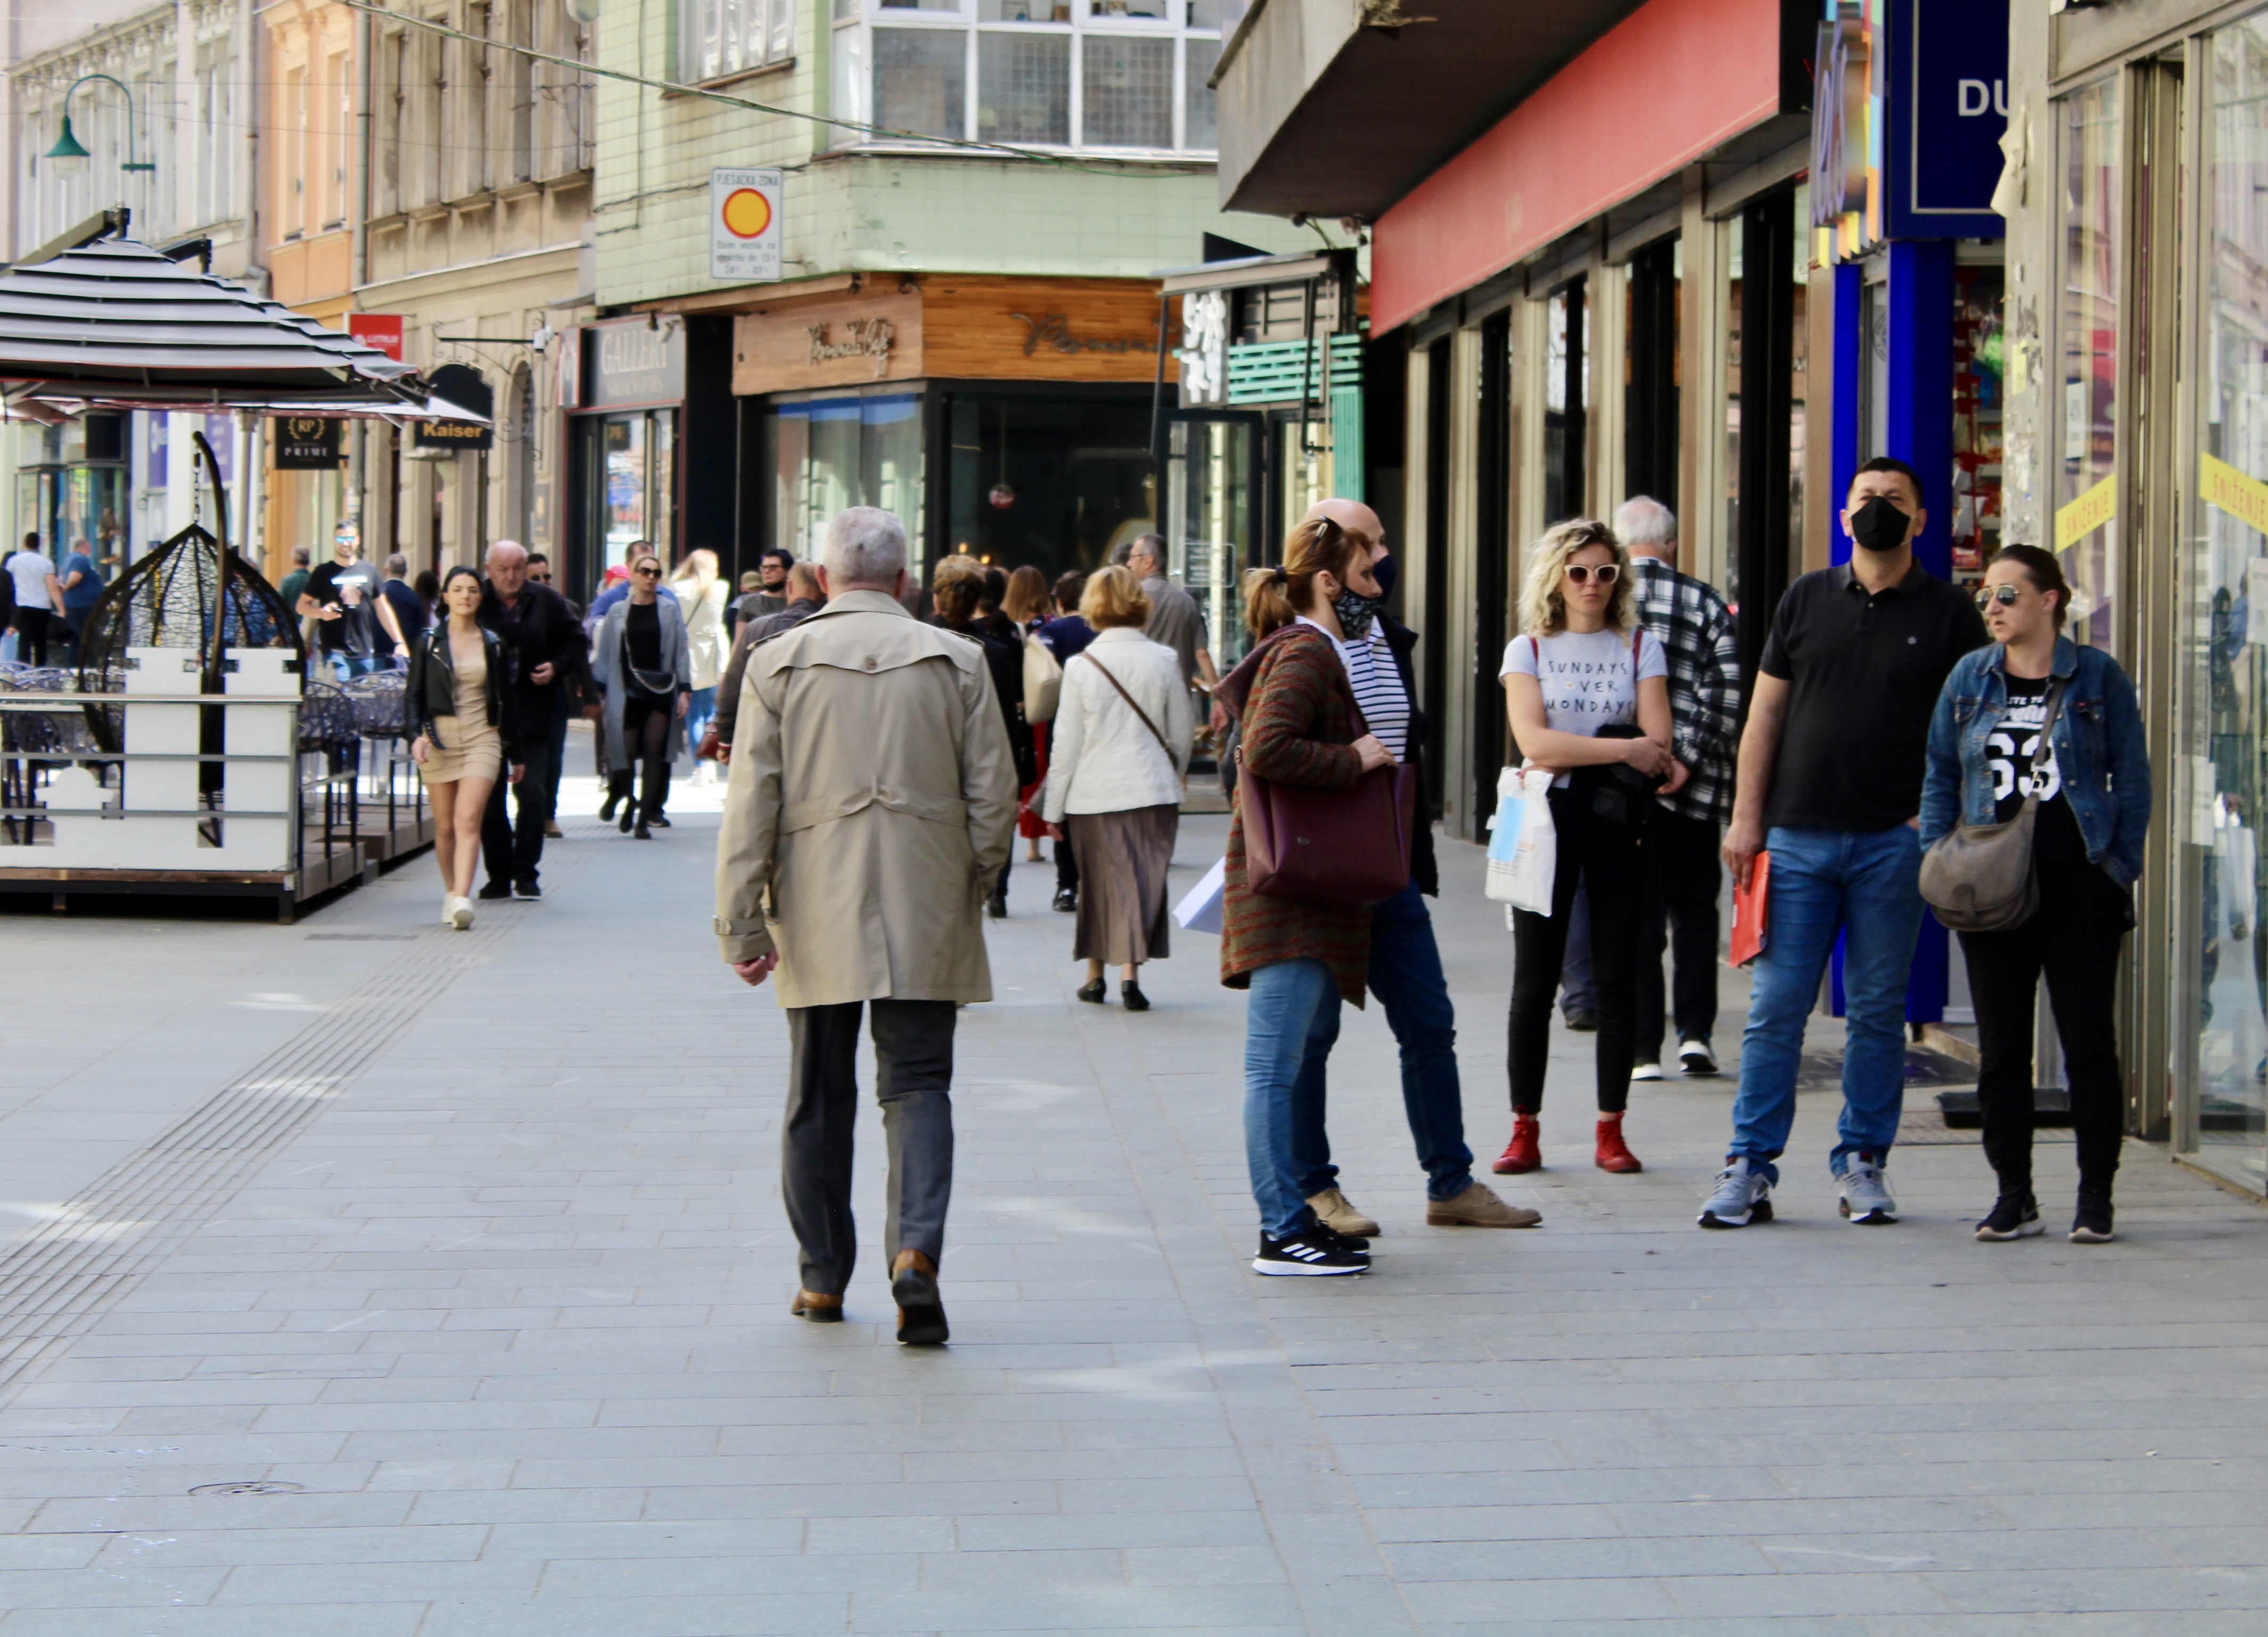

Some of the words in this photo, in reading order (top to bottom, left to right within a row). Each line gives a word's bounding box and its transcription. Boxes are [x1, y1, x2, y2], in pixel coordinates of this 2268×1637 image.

[423, 422, 484, 438] Kaiser
[284, 447, 327, 457] PRIME
[2213, 472, 2266, 525] SNIŽENJE
[2066, 490, 2109, 539] SNIŽENJE
[1548, 661, 1628, 675] SUNDAYS
[1546, 699, 1633, 716] MONDAYS
